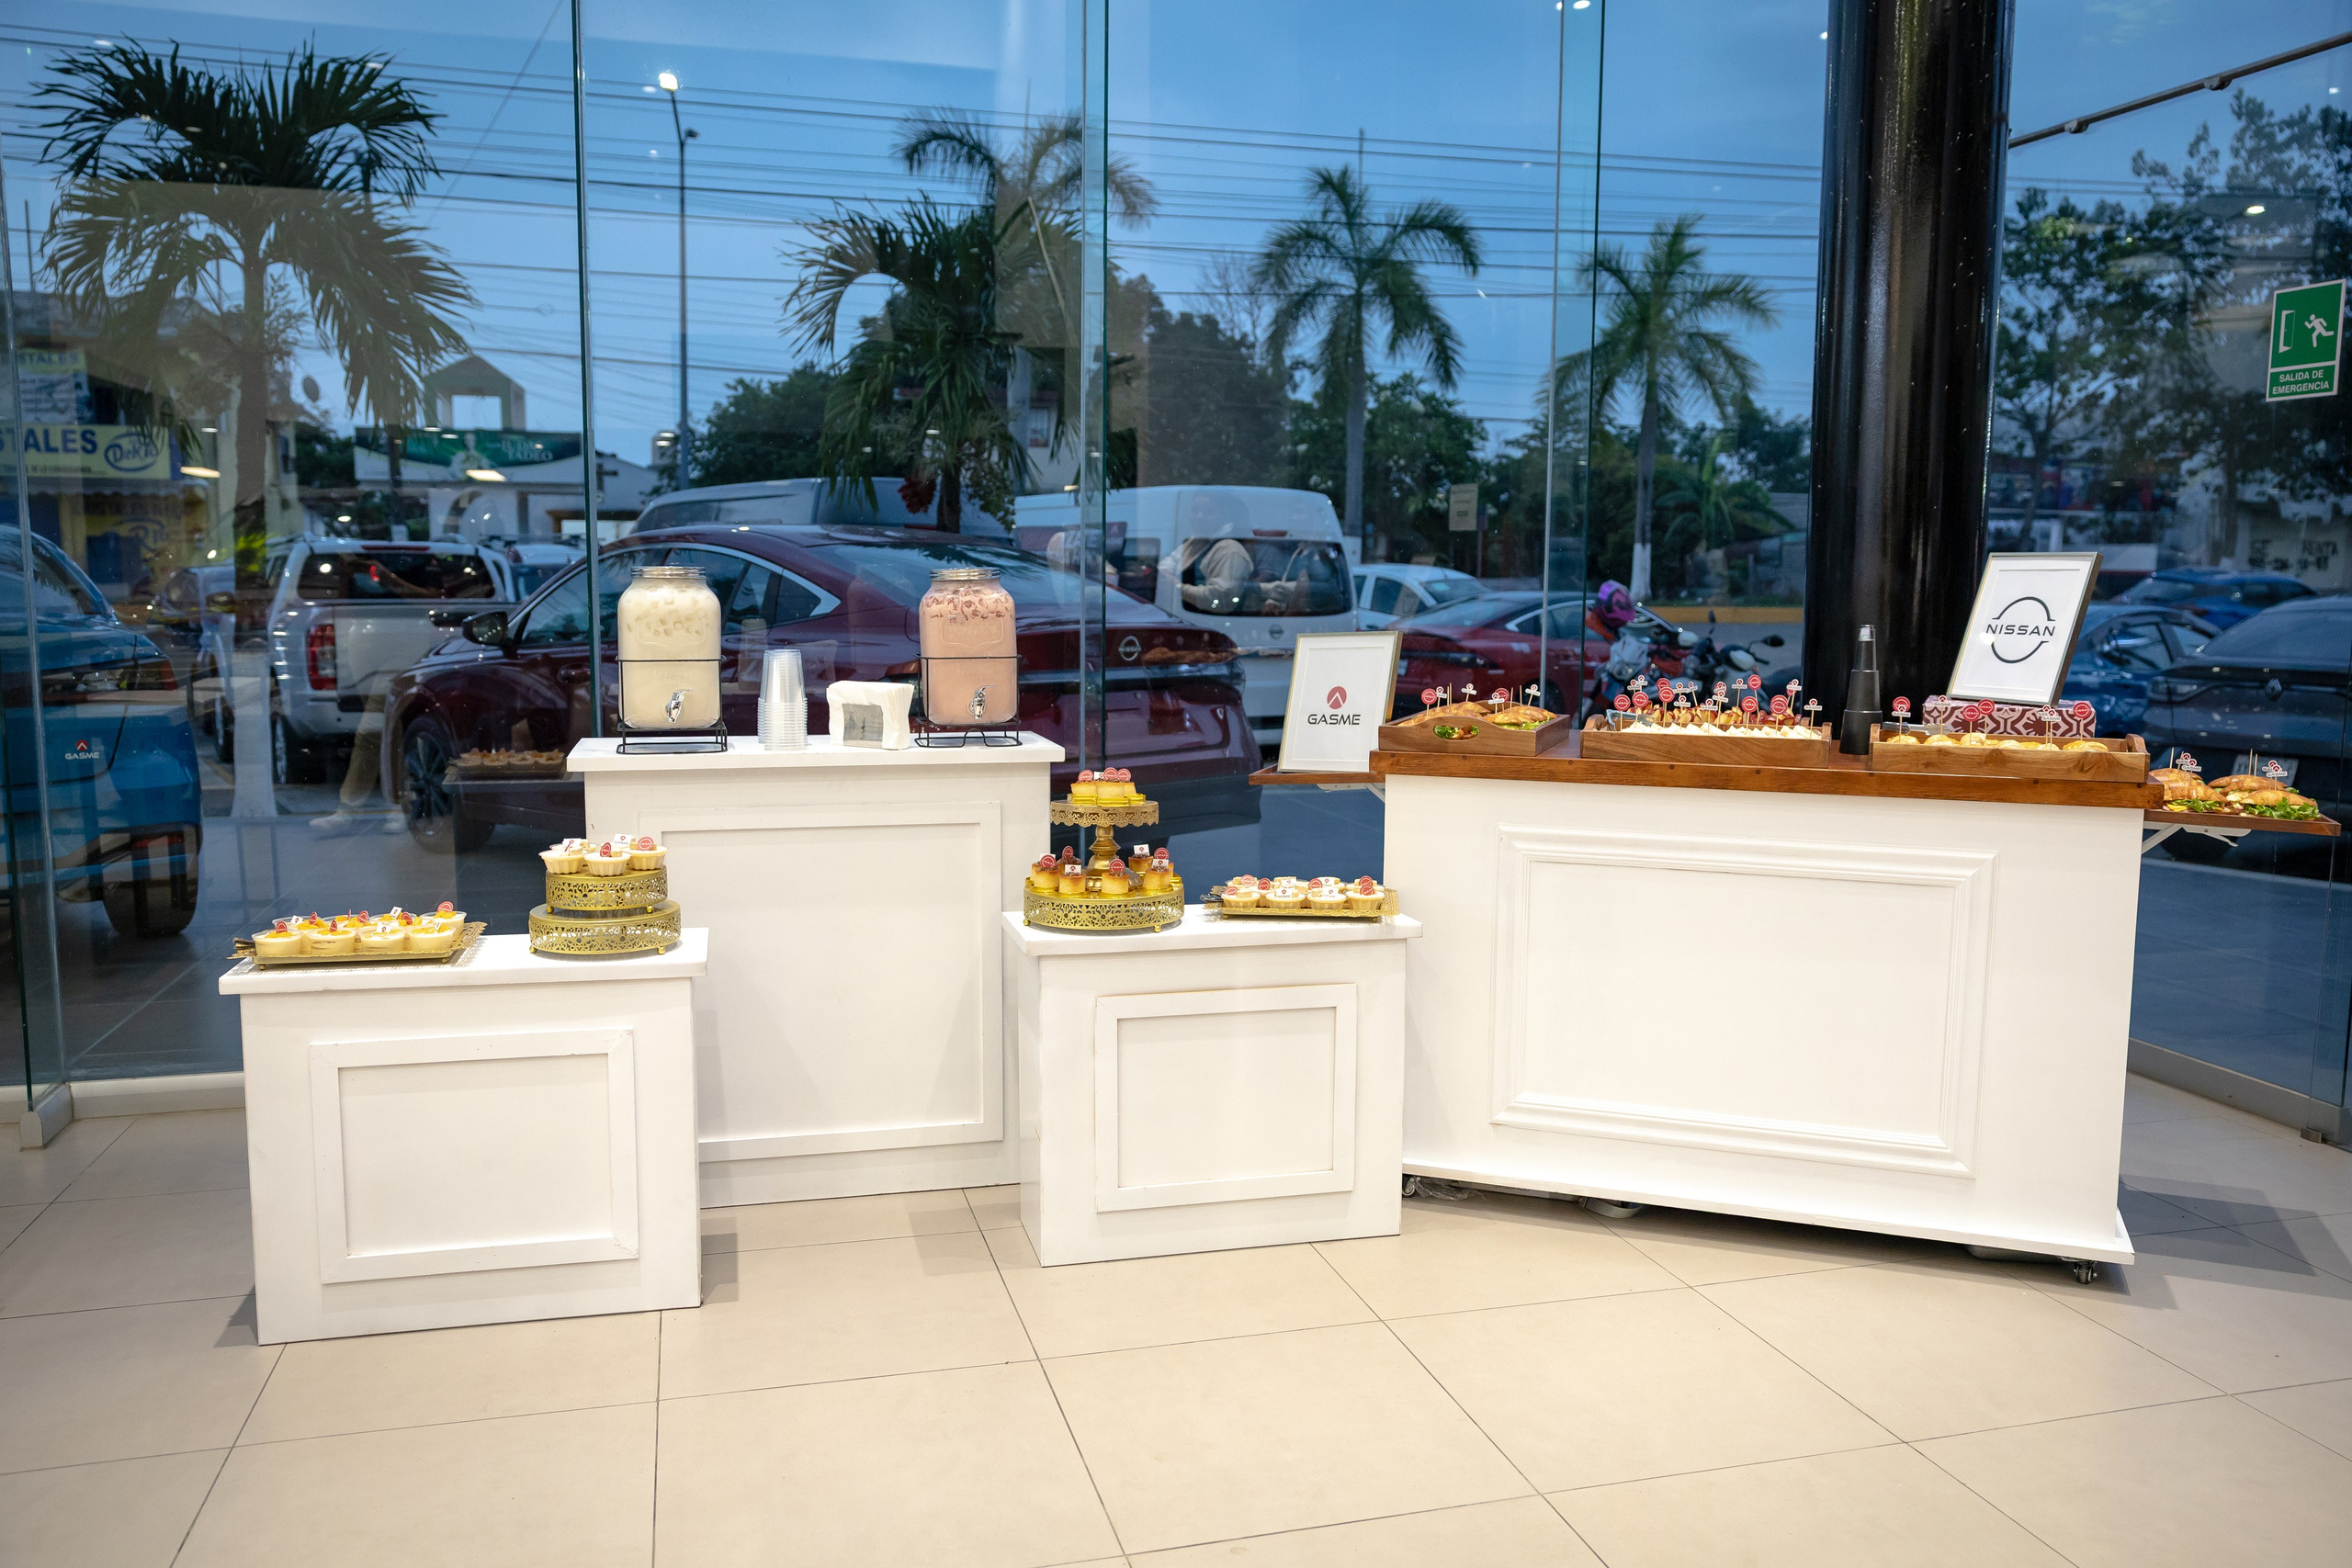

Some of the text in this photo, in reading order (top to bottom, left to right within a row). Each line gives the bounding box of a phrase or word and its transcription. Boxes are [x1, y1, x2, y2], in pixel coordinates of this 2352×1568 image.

[2279, 369, 2324, 383] SALIDA DE
[2272, 380, 2330, 395] EMERGENCIA
[1985, 624, 2056, 637] NISSAN
[1307, 714, 1362, 726] GASME
[64, 751, 100, 761] GASME
